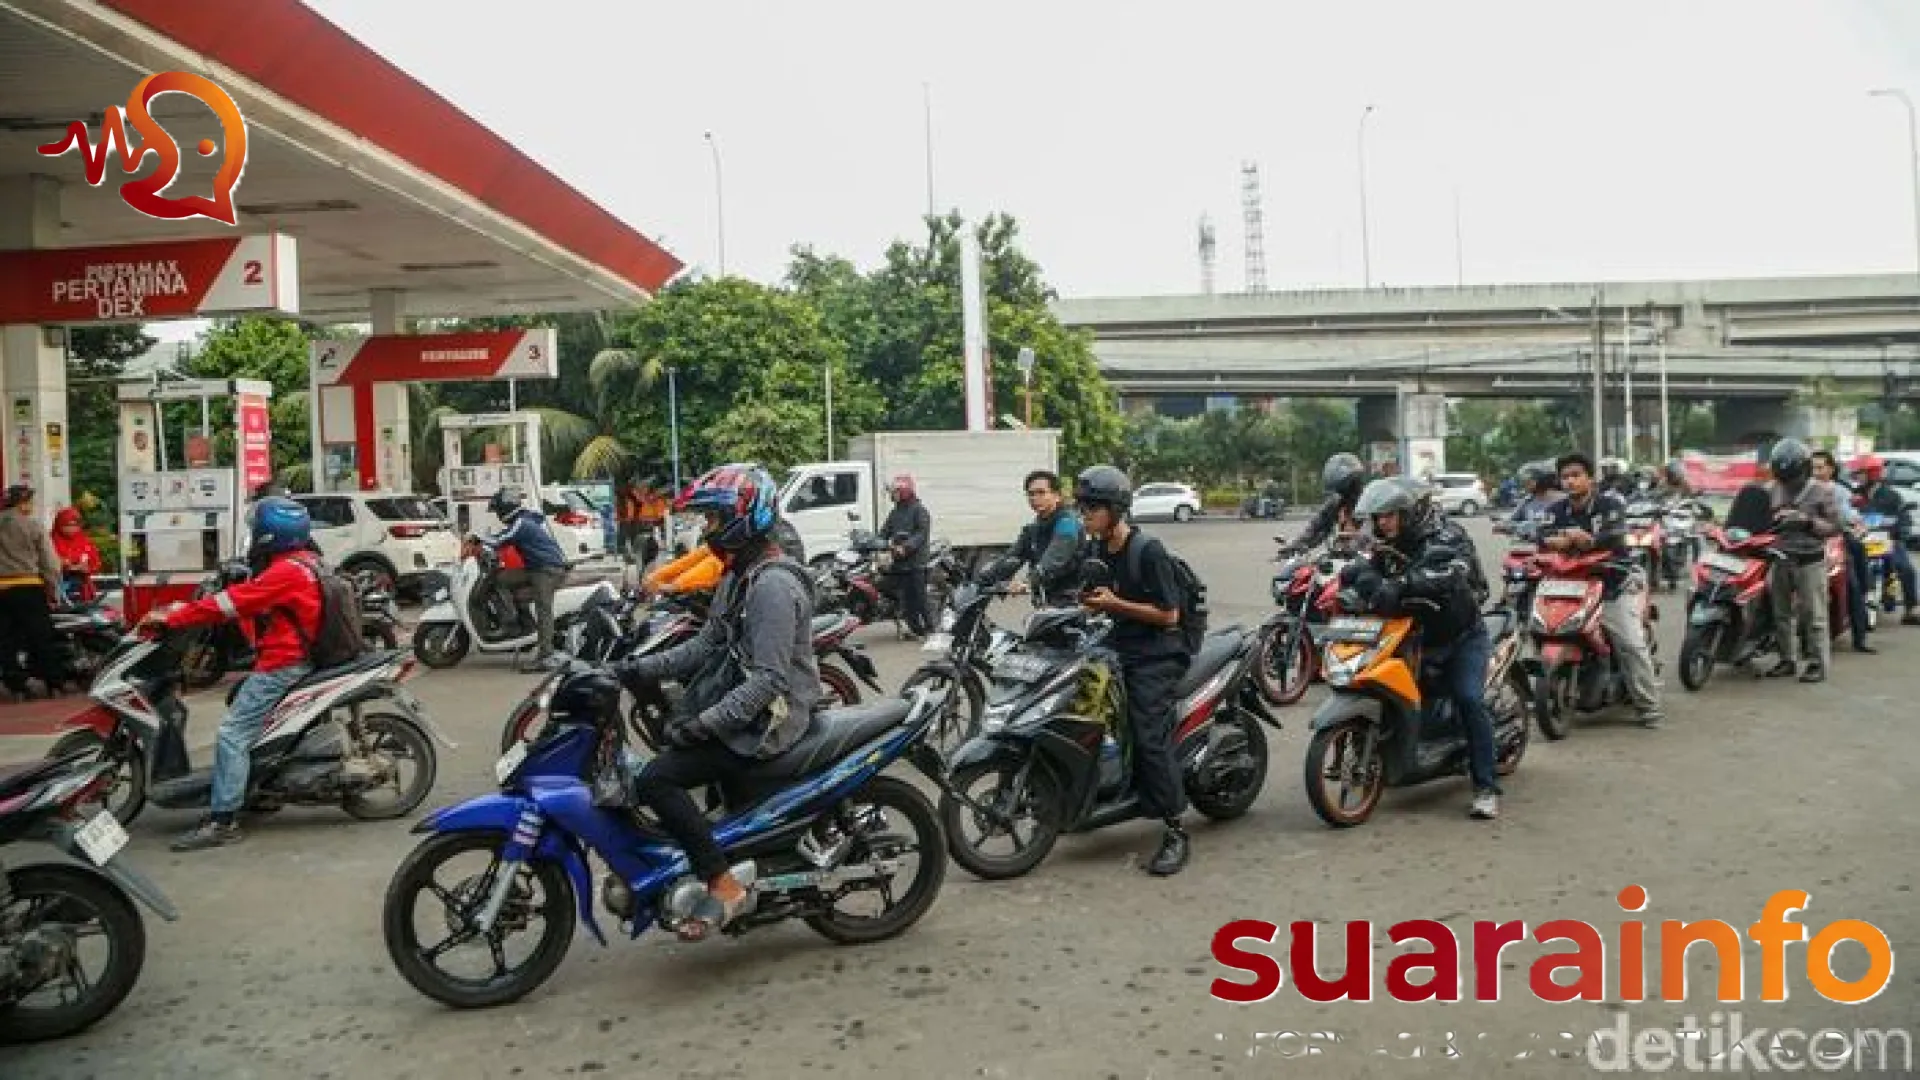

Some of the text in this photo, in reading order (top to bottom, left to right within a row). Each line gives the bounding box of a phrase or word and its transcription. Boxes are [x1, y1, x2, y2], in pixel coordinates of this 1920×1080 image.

[243, 260, 263, 285] 2
[52, 272, 188, 302] PERTAMINA
[98, 295, 145, 319] DEX
